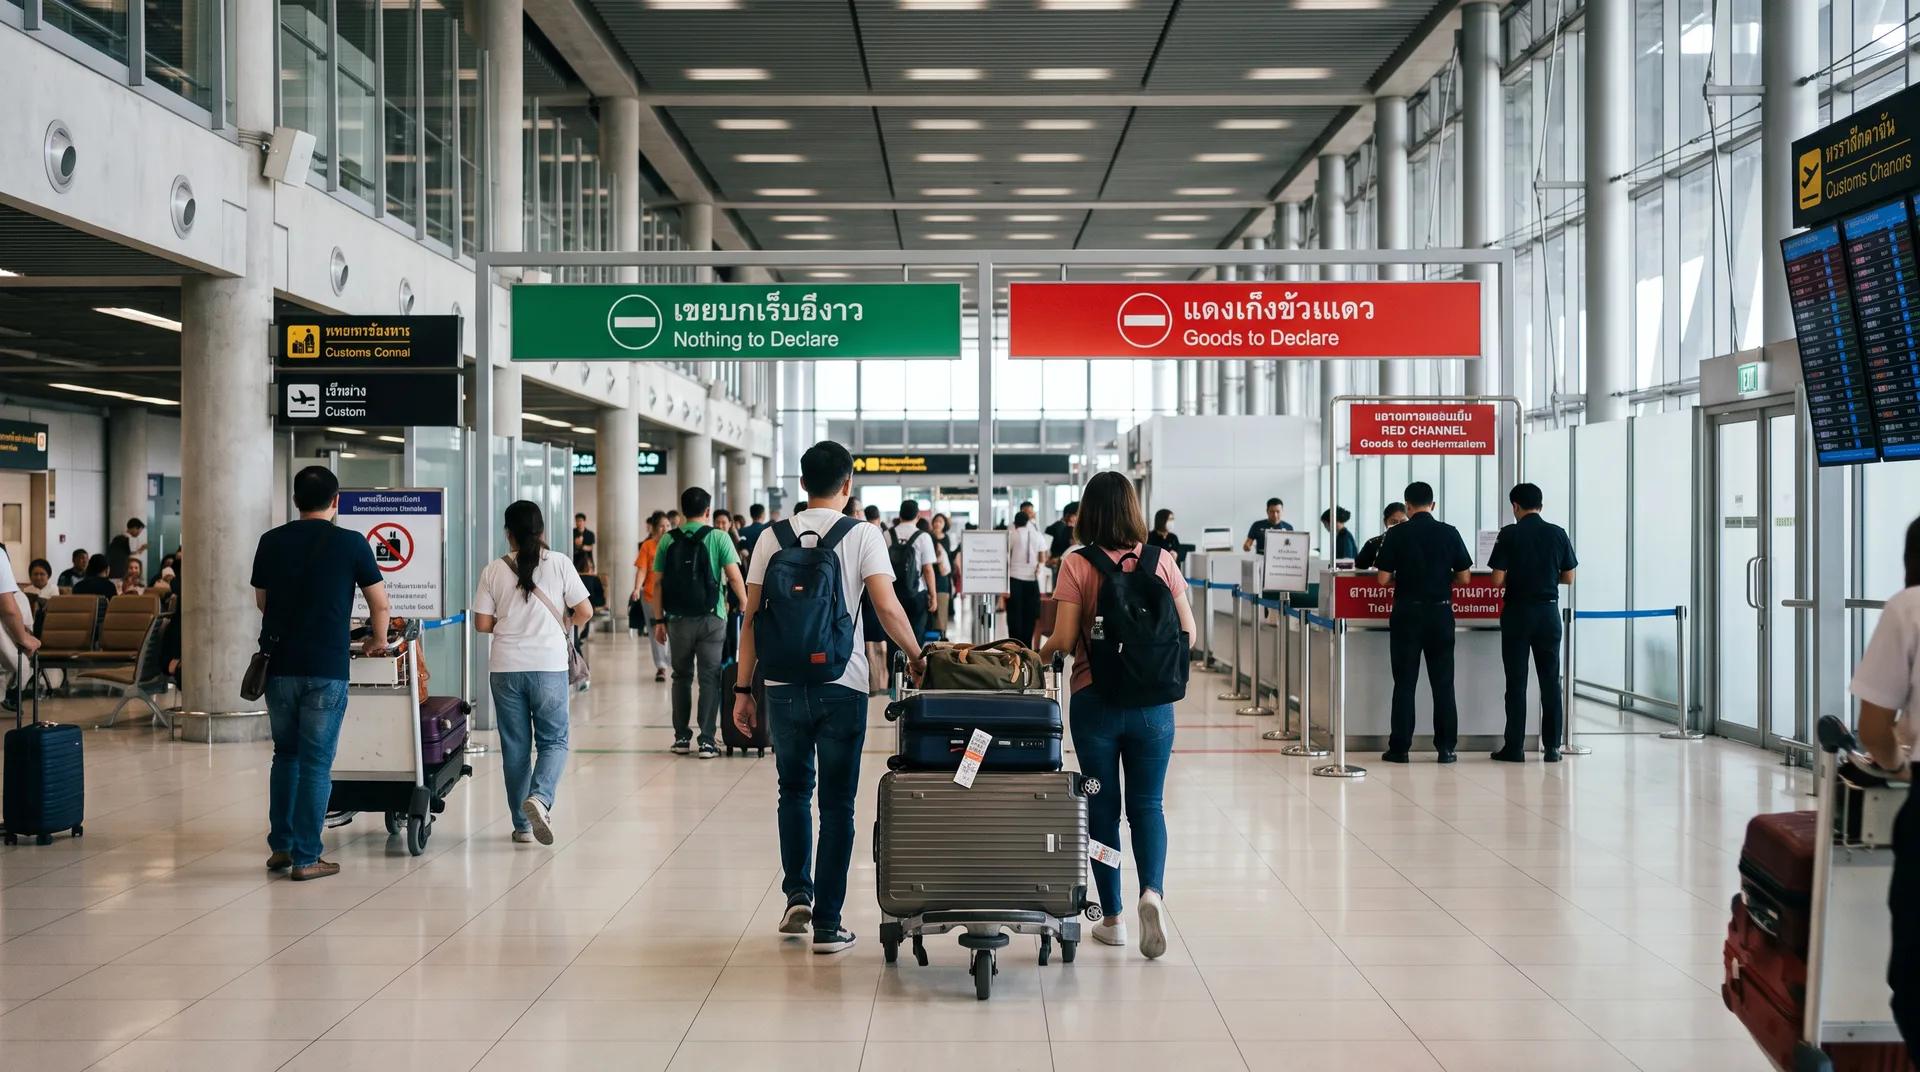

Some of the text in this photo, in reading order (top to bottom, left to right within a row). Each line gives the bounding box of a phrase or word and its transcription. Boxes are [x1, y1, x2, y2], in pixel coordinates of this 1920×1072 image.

[1827, 172, 1867, 199] Customs
[674, 331, 838, 351] Nothing to Declare
[1184, 330, 1339, 346] Goods to Declare
[326, 347, 410, 357] Customs Connal
[325, 406, 365, 416] Custom
[1381, 425, 1467, 435] RED CHANNEL
[1359, 438, 1395, 448] Goods
[1397, 440, 1408, 448] to
